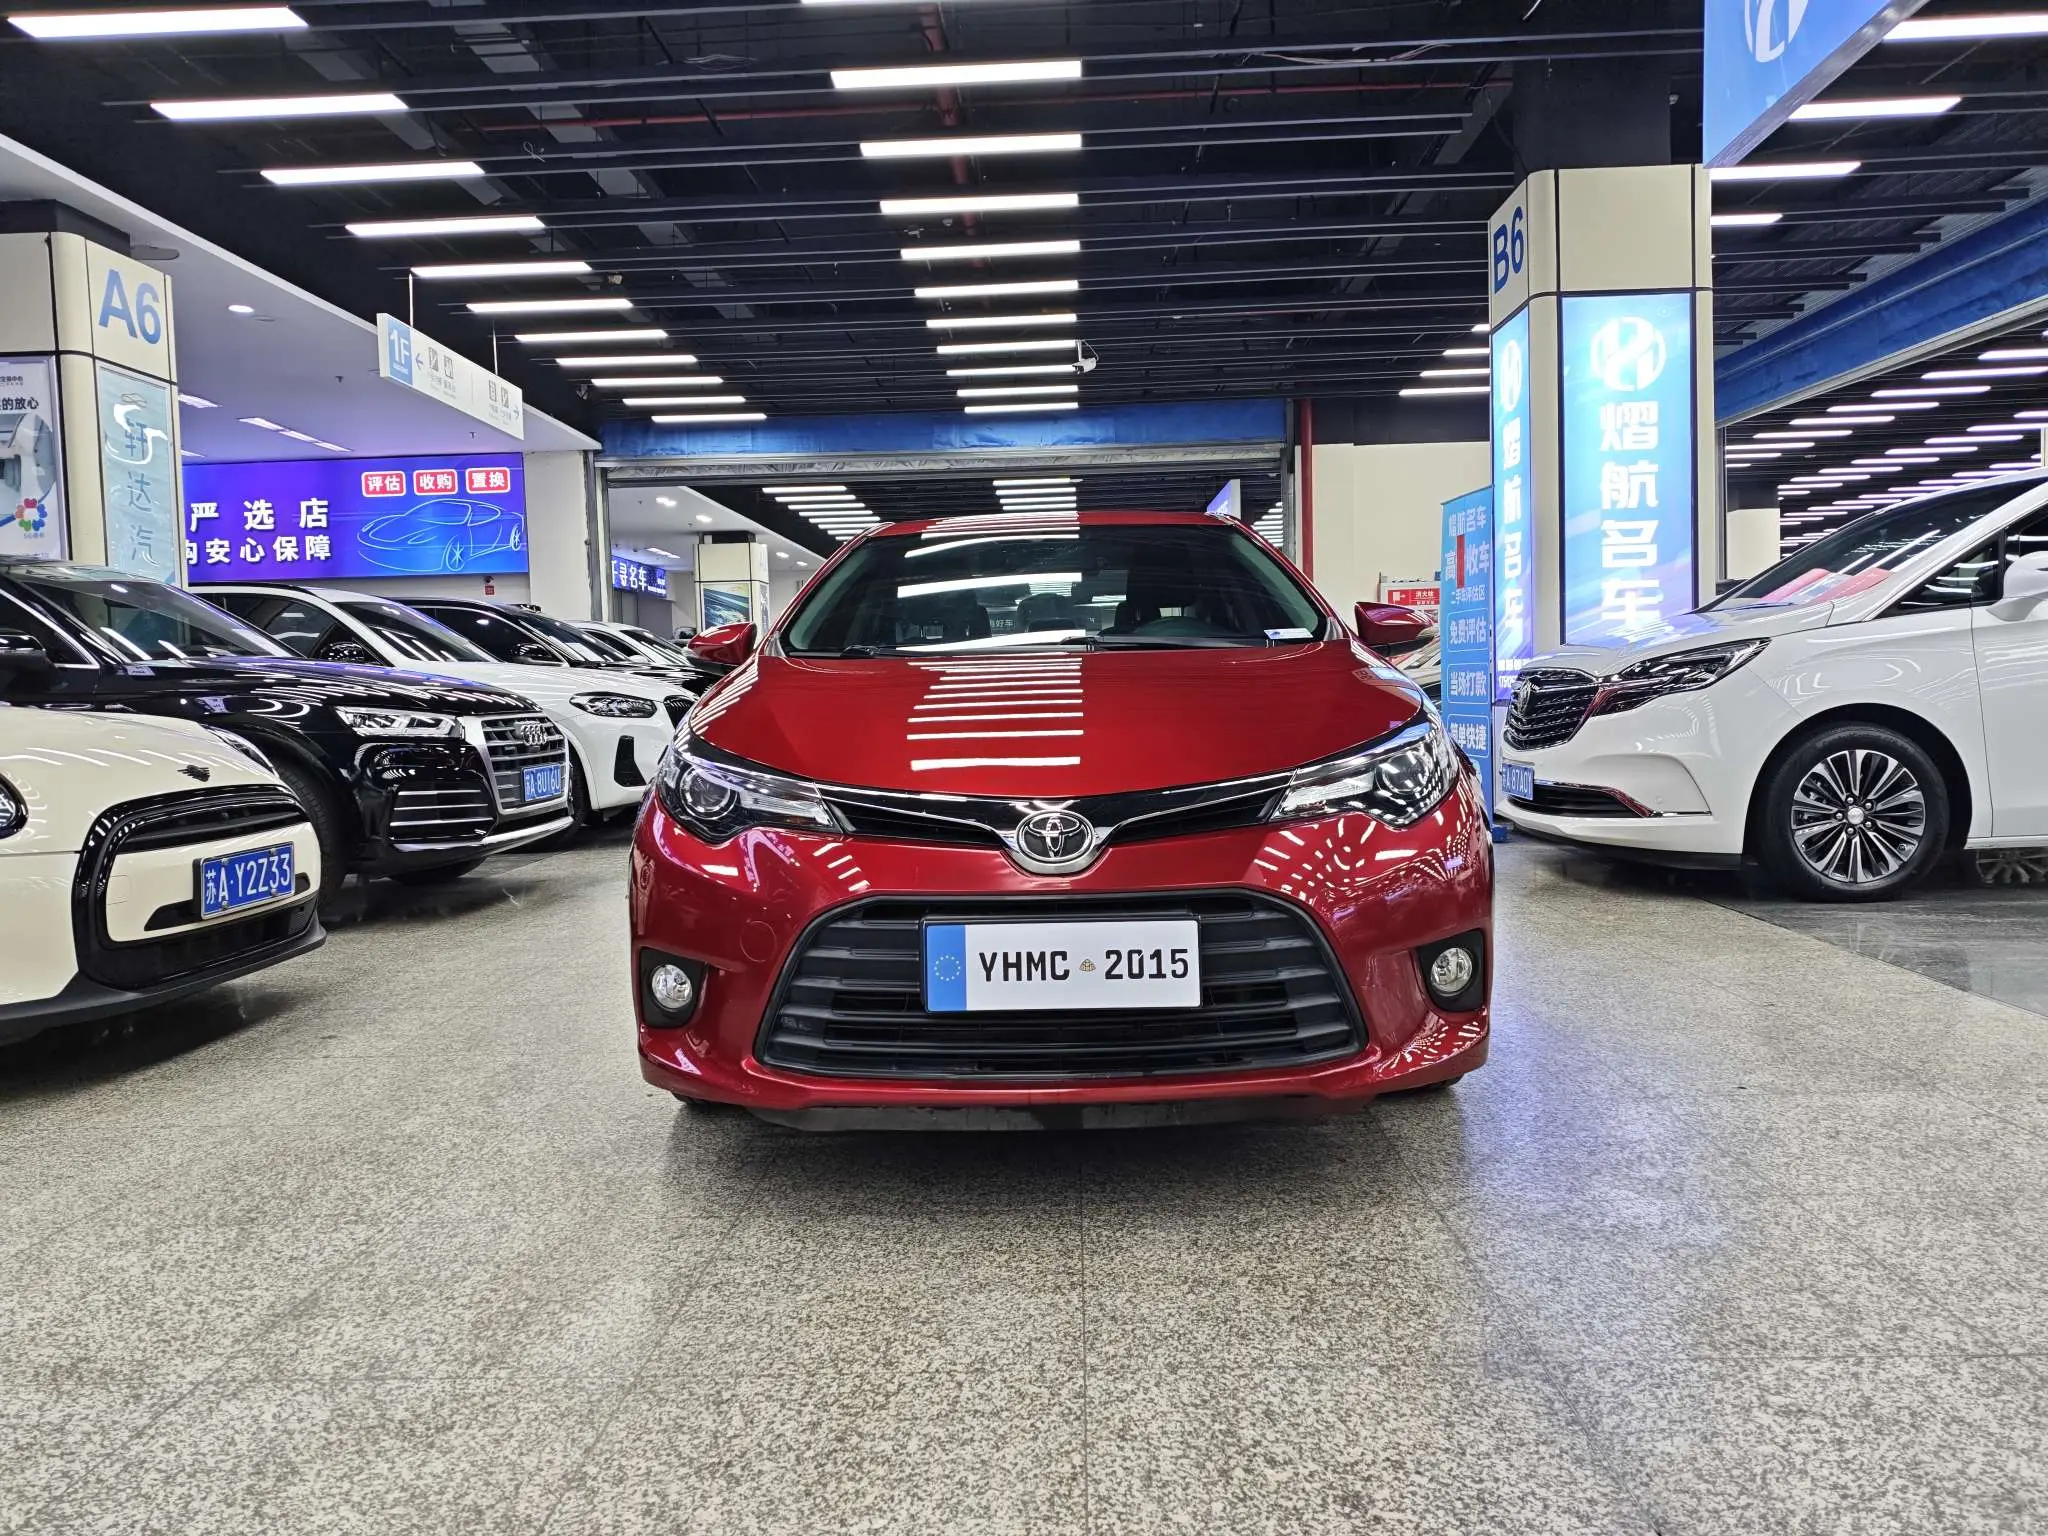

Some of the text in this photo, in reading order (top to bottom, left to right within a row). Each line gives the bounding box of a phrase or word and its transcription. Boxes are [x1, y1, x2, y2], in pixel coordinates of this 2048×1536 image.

[1493, 206, 1524, 294] B6
[99, 269, 161, 344] A6
[390, 328, 410, 365] 1F
[0, 397, 39, 410] 的放心
[367, 472, 505, 492] 评估 收购 置换
[190, 498, 328, 532] 严选店
[1600, 401, 1661, 628] 熠航名车
[1445, 541, 1489, 580] 高收车
[1450, 616, 1487, 644] 免费评估
[1450, 672, 1487, 696] 当场打款
[206, 853, 290, 904] 苏A·Y2Z33
[979, 949, 1189, 982] YHMC 2015
